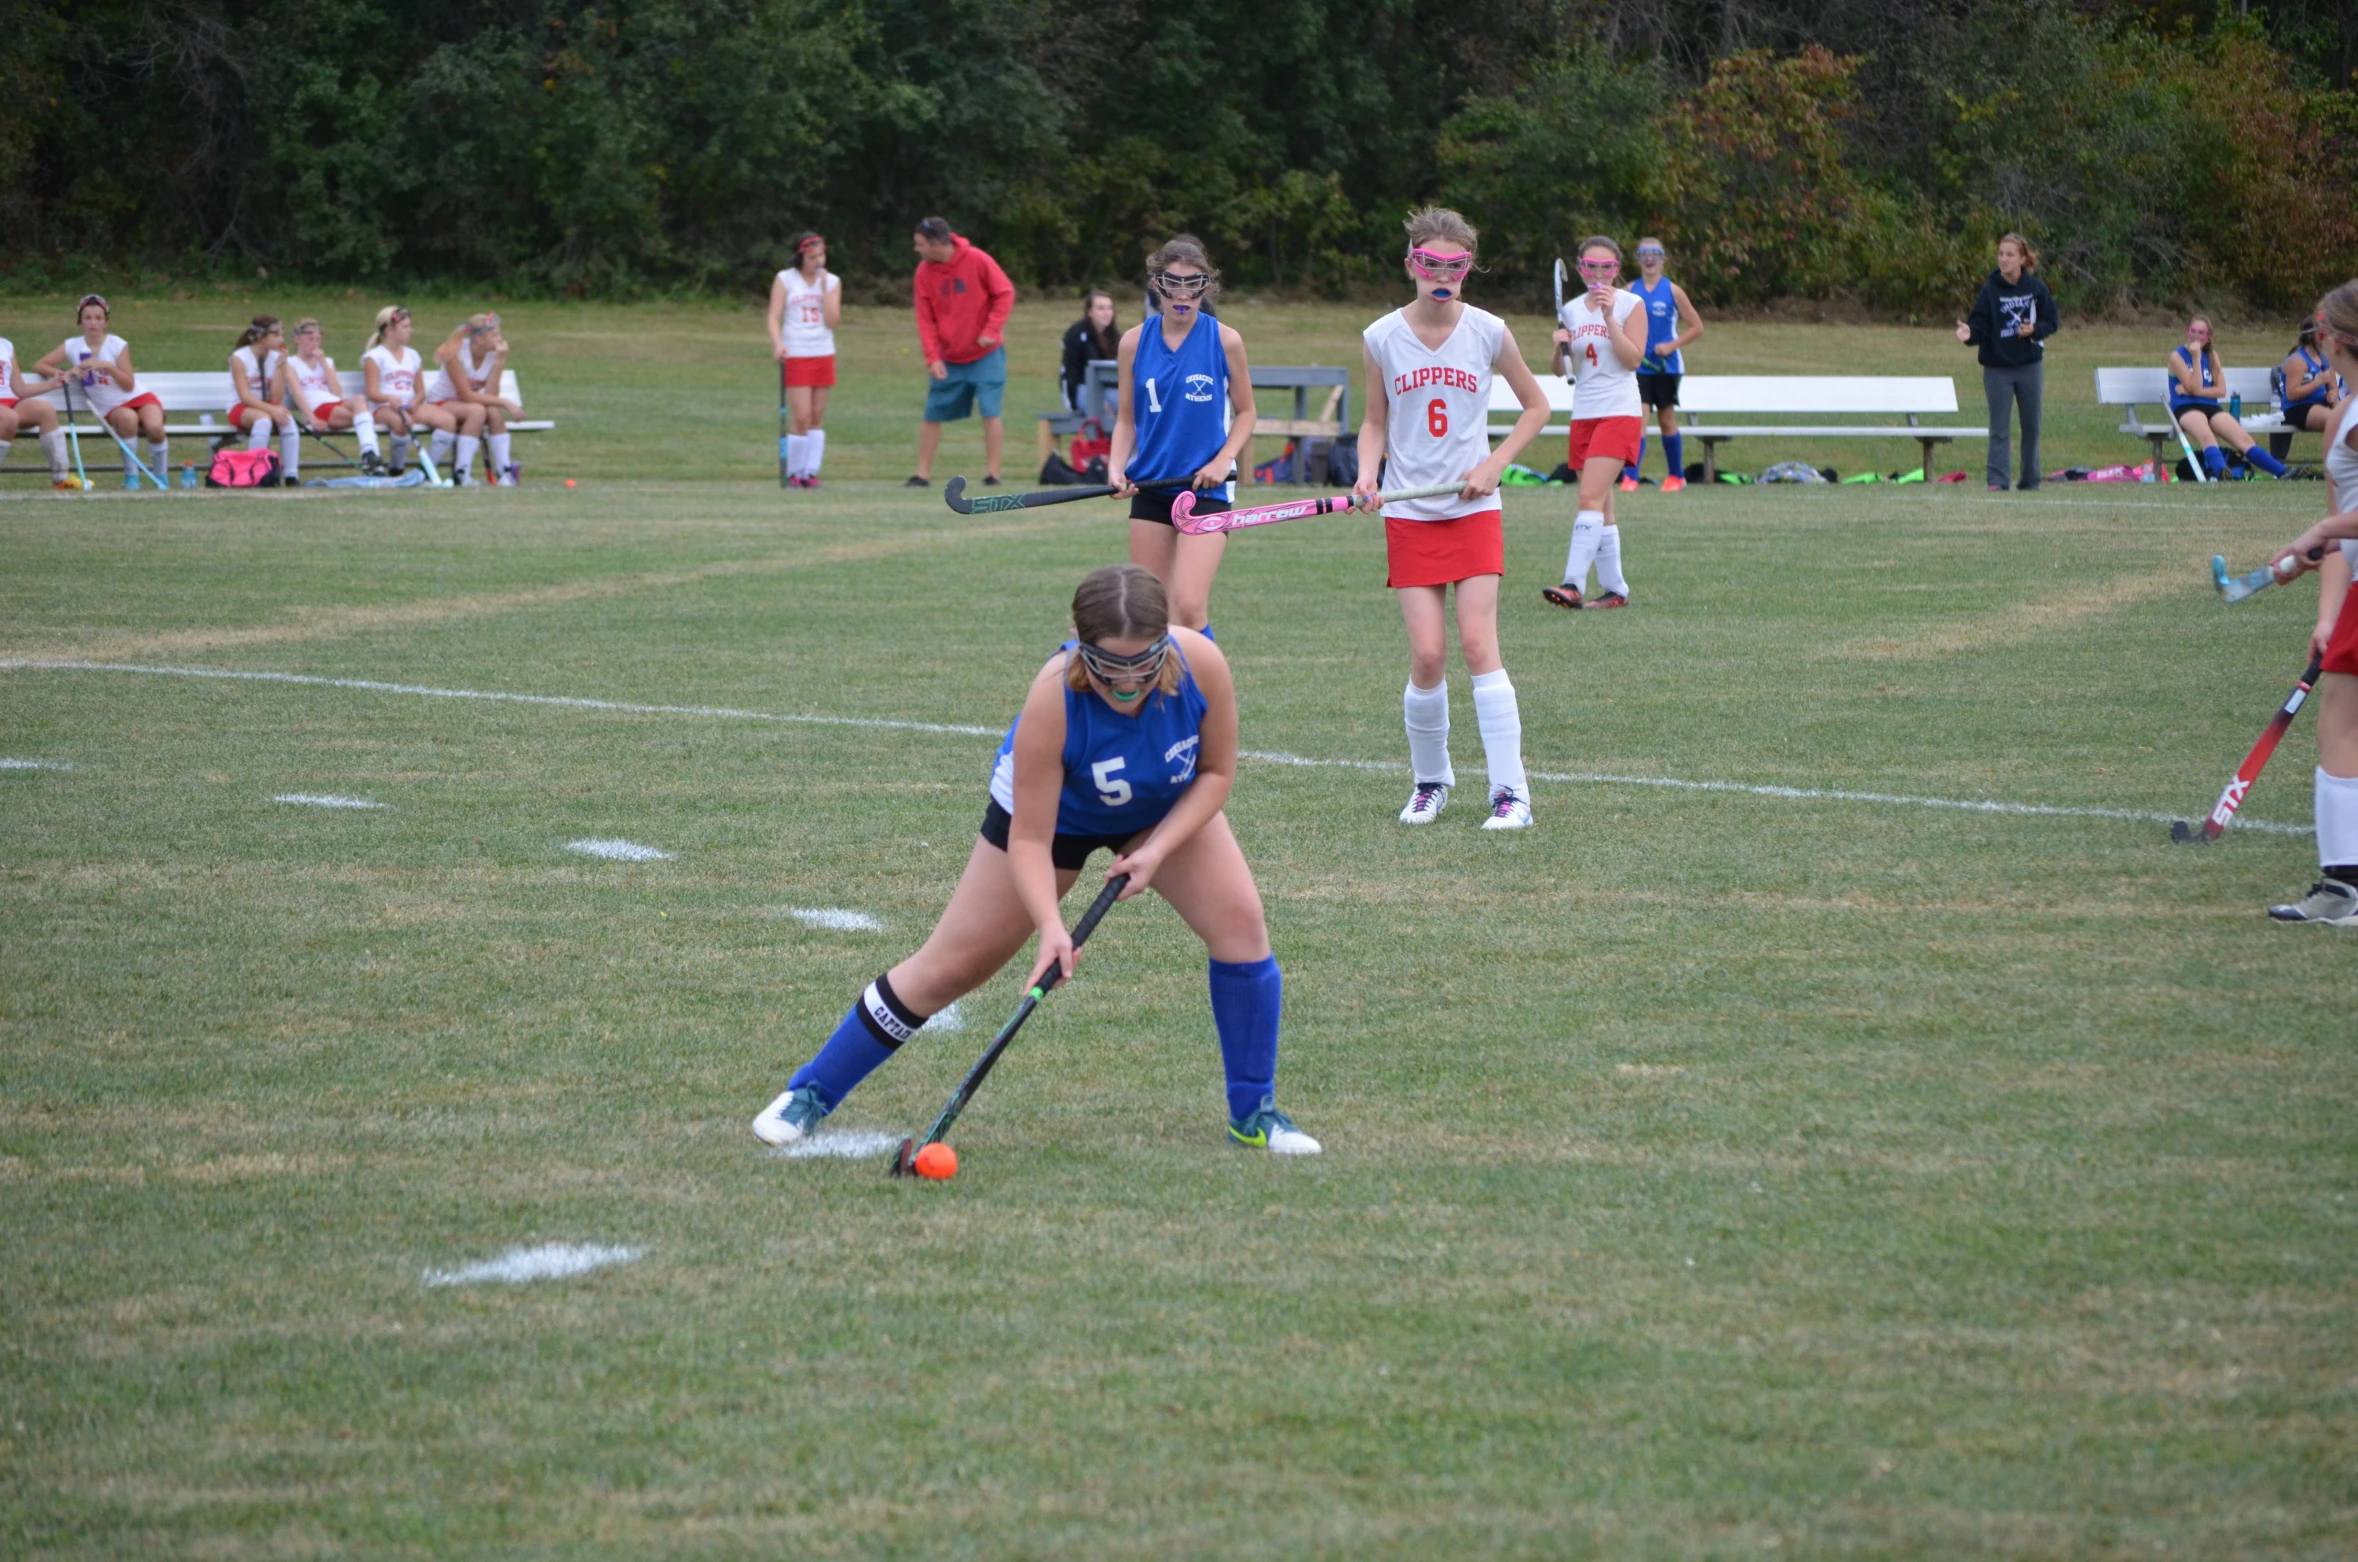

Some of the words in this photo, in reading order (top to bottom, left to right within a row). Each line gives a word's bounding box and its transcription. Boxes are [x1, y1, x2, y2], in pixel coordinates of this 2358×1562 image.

[1570, 323, 1611, 340] LIPPER
[1585, 342, 1598, 367] 4
[1394, 366, 1477, 396] CLIPPERS
[1145, 377, 1162, 413] 1
[1184, 392, 1213, 403] ATHENS
[1427, 398, 1449, 438] 6
[971, 492, 1027, 514] STX
[1231, 505, 1308, 526] harrow
[1091, 755, 1133, 807] 5
[2211, 774, 2250, 827] STX
